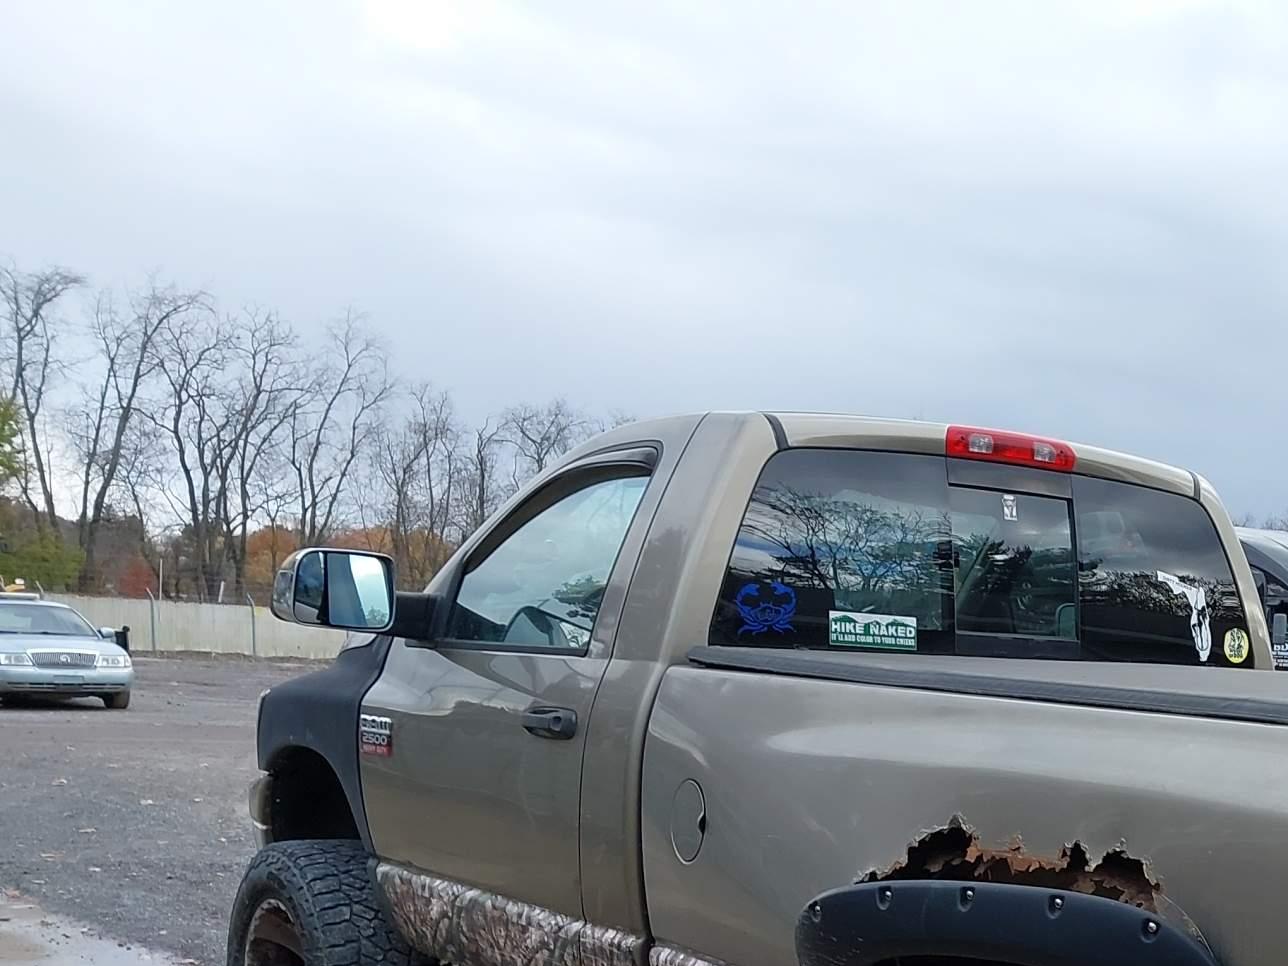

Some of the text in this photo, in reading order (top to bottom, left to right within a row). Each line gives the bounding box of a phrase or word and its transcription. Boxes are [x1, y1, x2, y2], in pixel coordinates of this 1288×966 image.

[831, 621, 915, 637] HIKE NAKED
[362, 732, 387, 745] 2500
